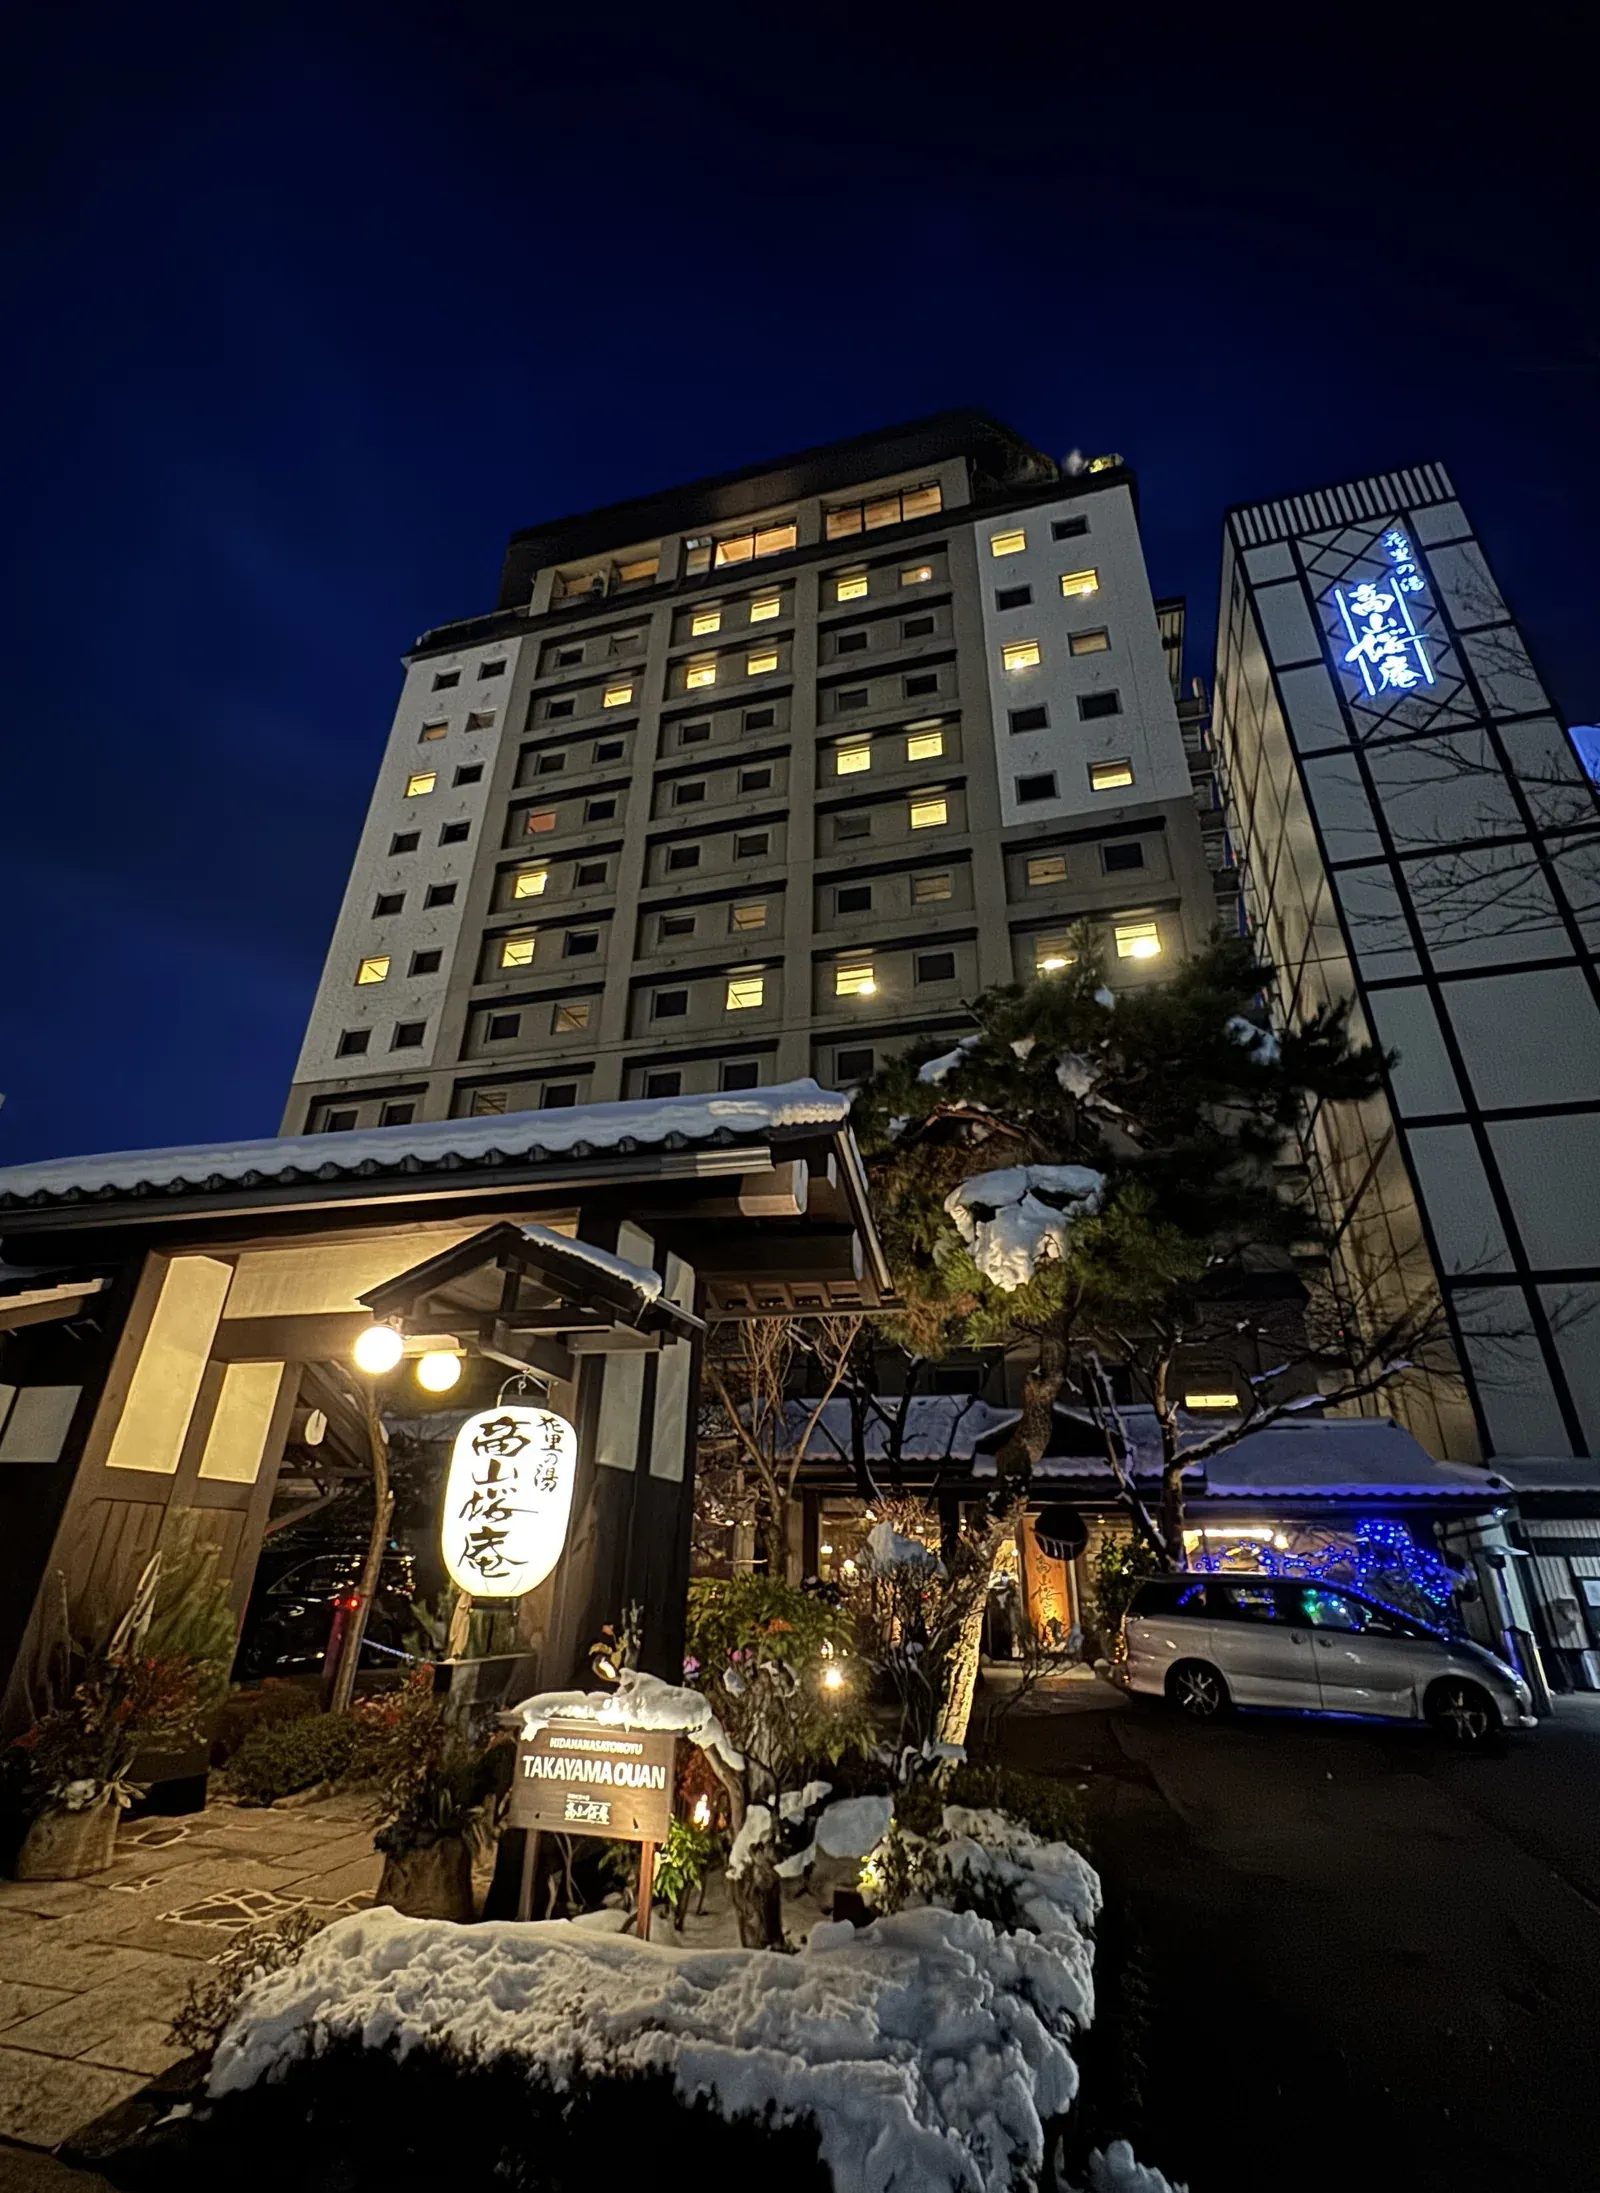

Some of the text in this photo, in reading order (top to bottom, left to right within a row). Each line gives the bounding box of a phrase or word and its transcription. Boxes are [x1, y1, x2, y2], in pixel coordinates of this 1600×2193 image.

[457, 1416, 539, 1578] 高山桜庵
[533, 1416, 565, 1492] 花里の湯
